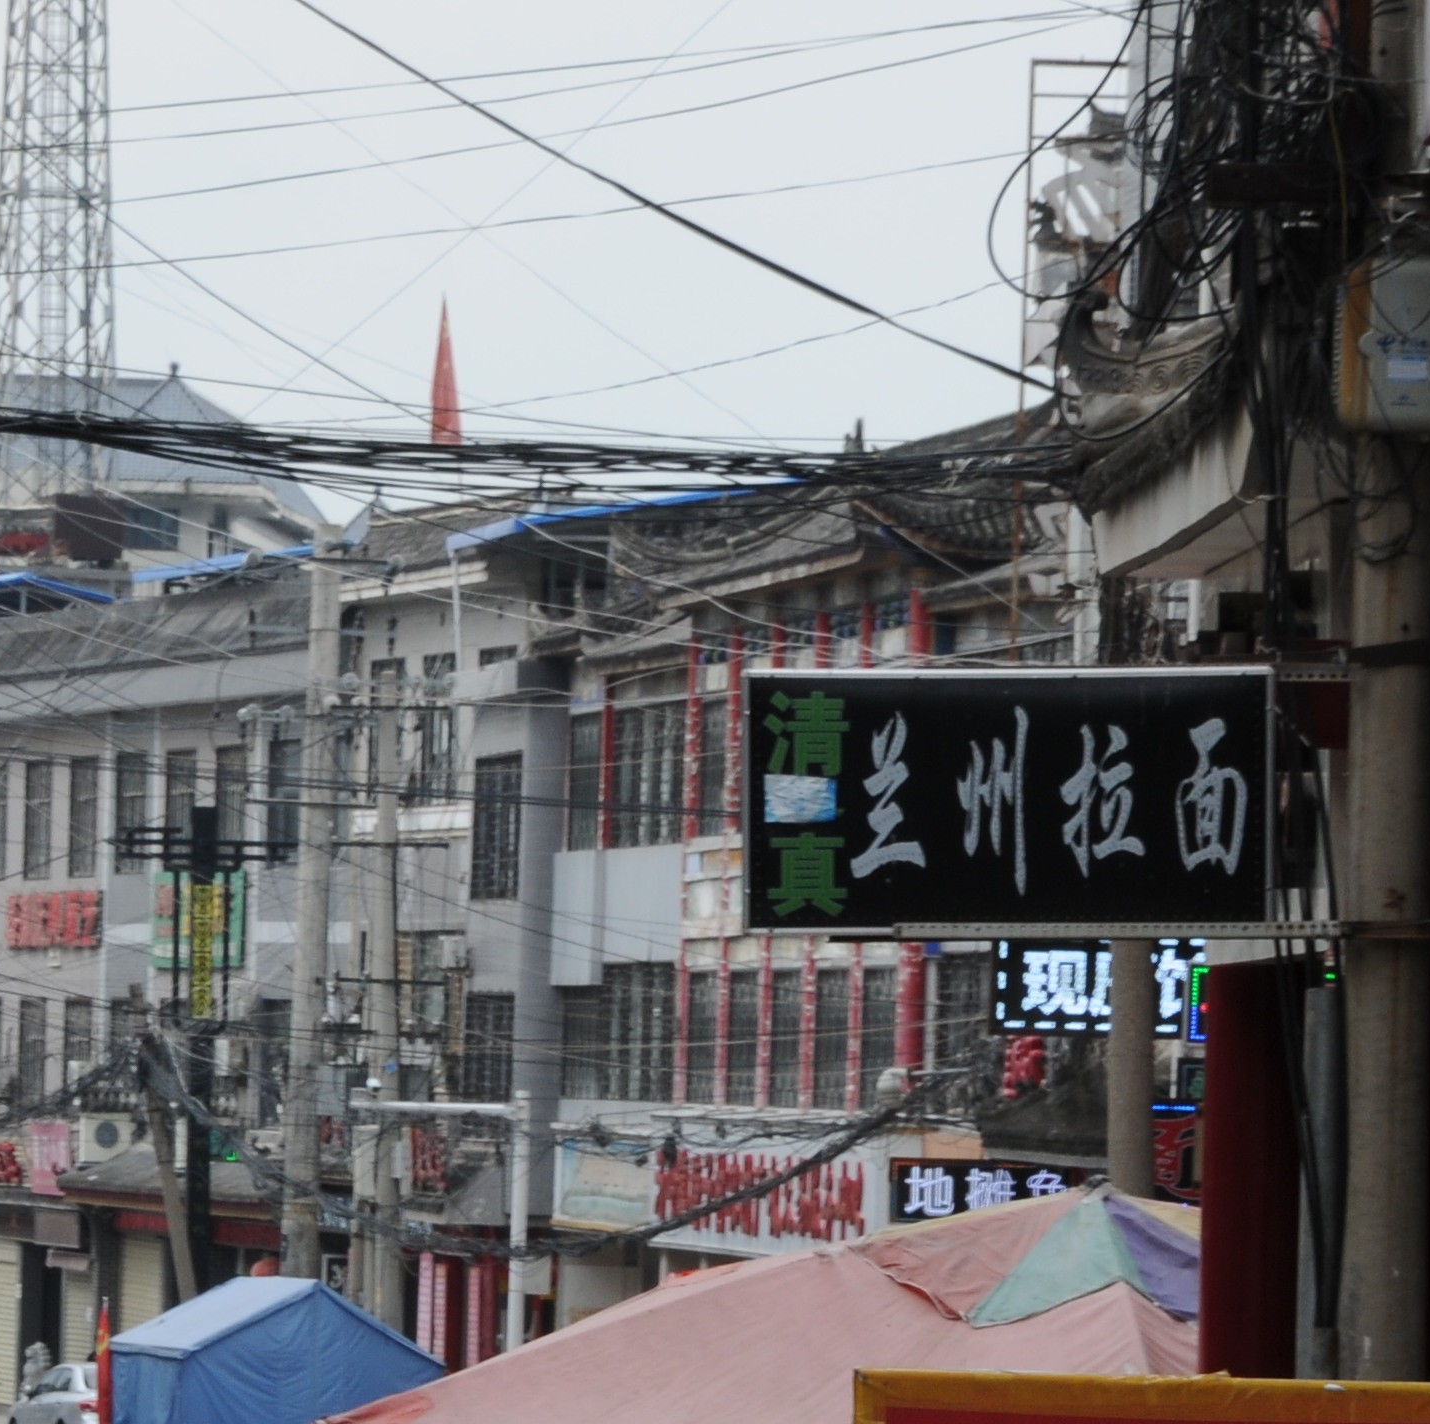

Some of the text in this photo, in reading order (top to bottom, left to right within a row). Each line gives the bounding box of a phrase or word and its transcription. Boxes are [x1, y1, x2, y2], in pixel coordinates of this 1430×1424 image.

[764, 690, 850, 917] 清真
[851, 706, 1248, 897] 兰州拉面
